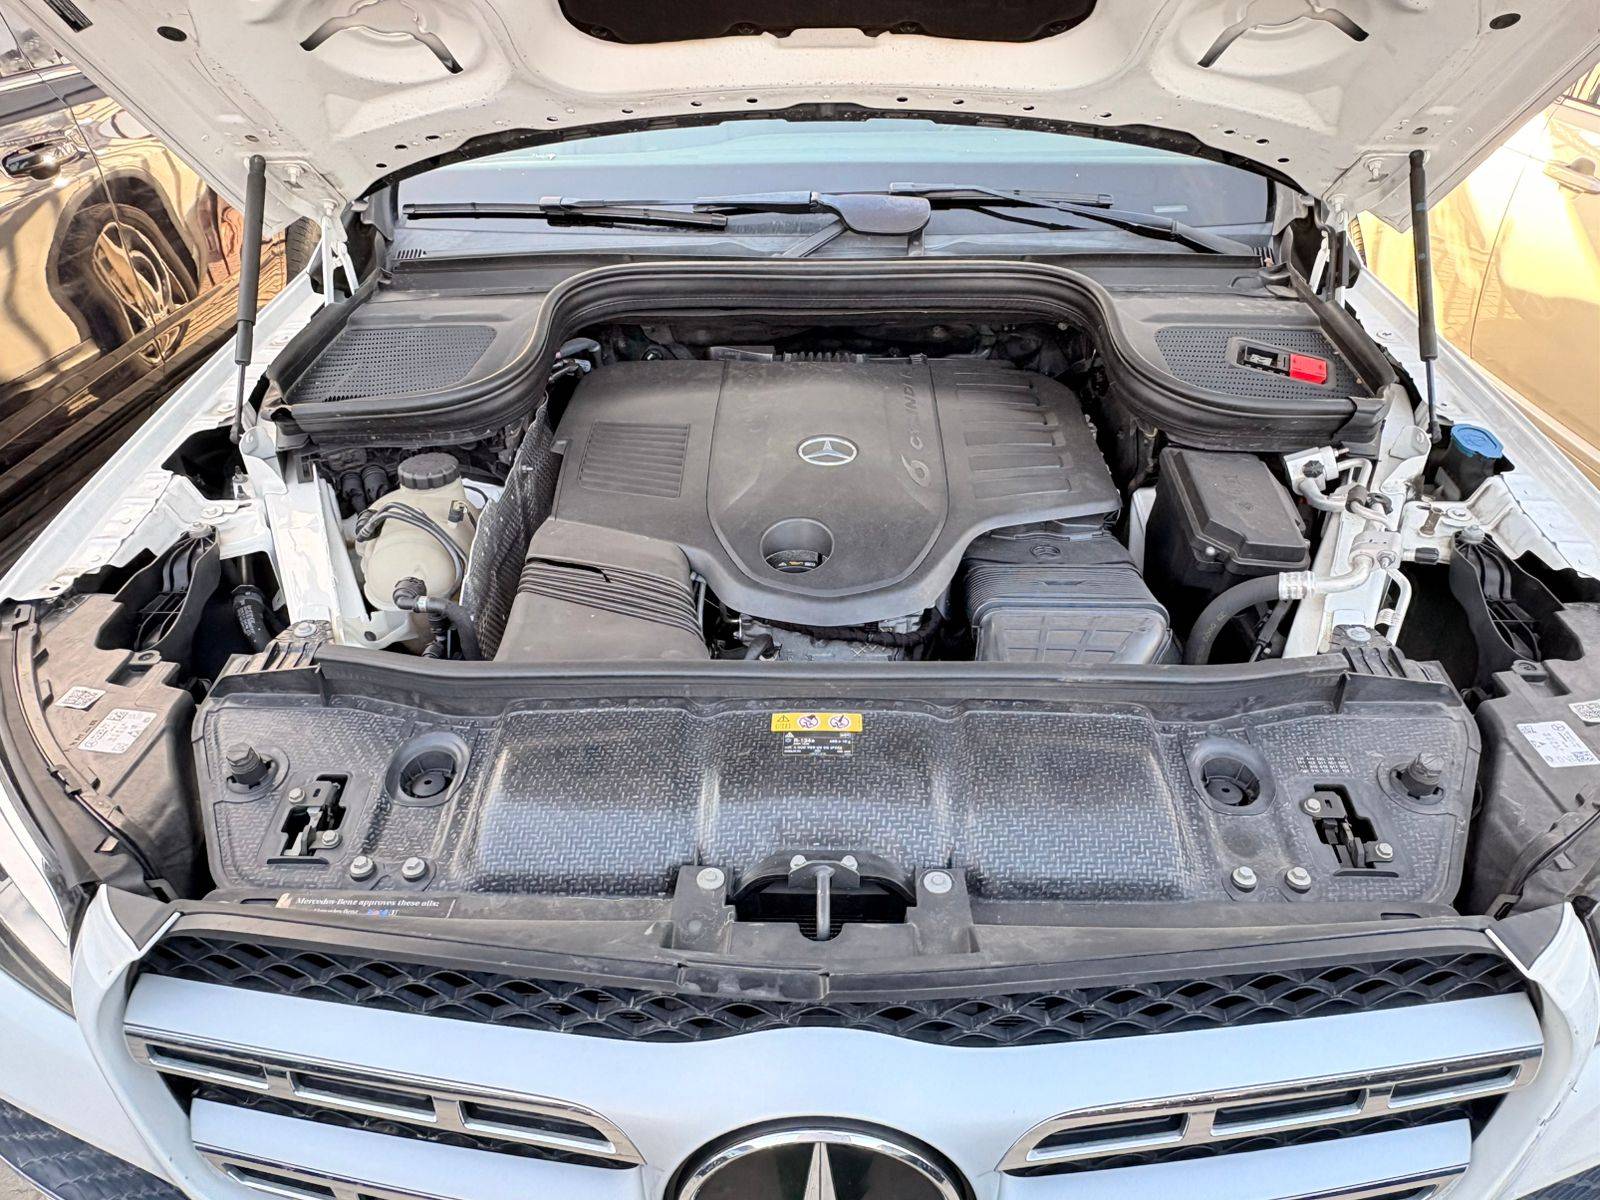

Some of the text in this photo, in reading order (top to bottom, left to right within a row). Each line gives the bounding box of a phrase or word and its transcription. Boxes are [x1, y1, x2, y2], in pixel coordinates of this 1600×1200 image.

[900, 453, 931, 487] 6
[358, 899, 395, 907] approves
[397, 899, 420, 907] these
